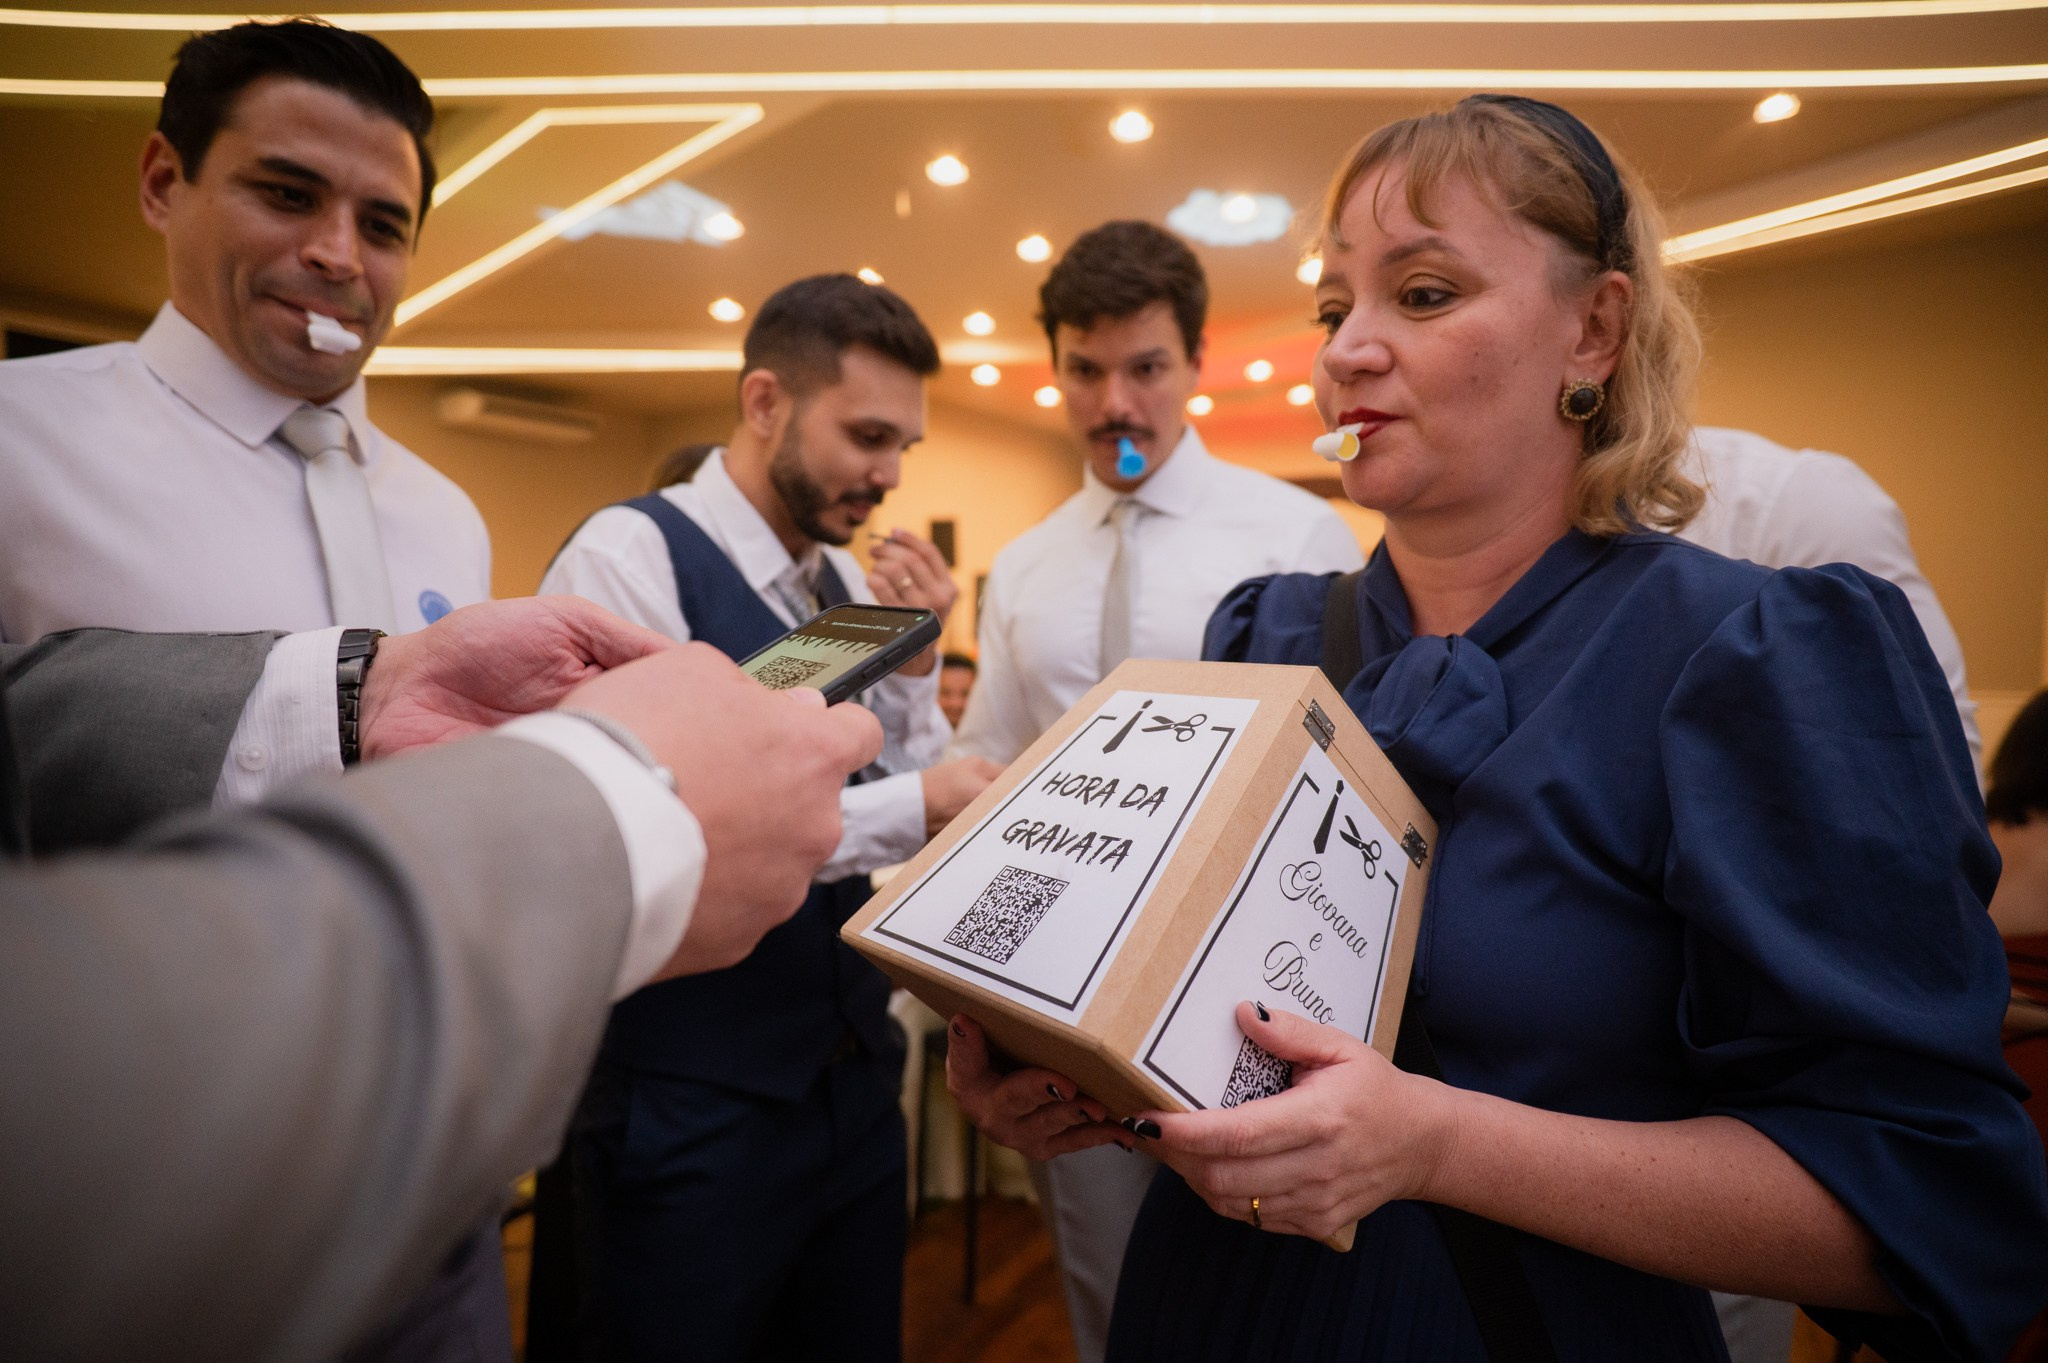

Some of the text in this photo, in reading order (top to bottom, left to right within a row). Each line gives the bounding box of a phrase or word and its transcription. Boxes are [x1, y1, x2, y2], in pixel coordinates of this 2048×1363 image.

[1041, 771, 1169, 817] HORA DA
[1001, 818, 1133, 872] GRAVATA
[1279, 860, 1367, 958] Giovana
[1309, 932, 1323, 952] e
[1263, 940, 1335, 1024] Bruno
